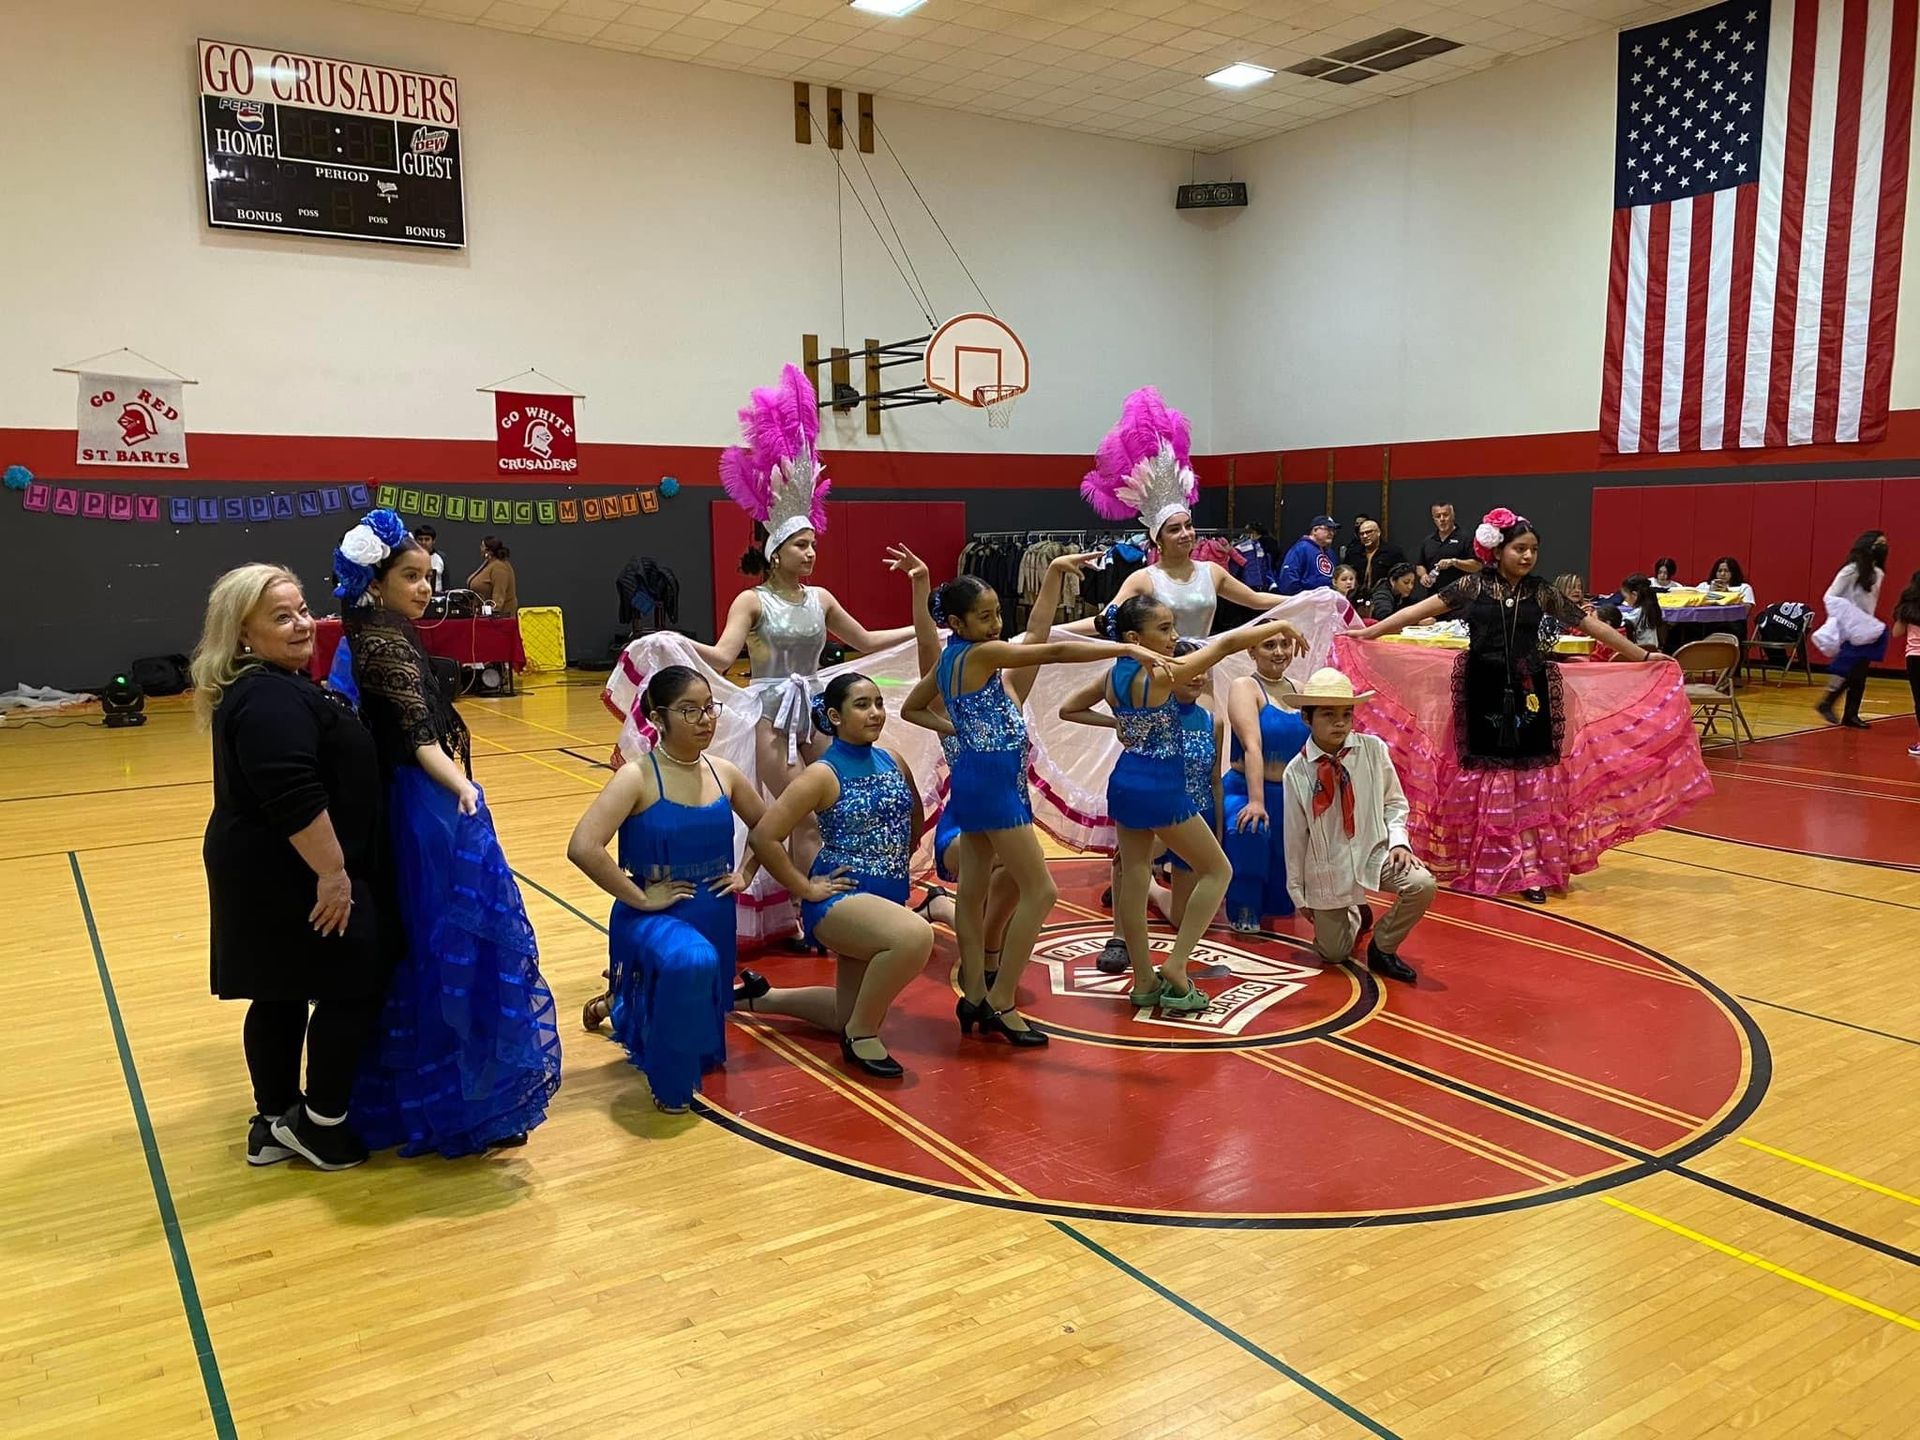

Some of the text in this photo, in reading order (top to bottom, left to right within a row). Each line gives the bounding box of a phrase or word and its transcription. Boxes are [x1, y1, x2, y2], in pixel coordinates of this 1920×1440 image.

[204, 44, 455, 123] GO CRUSADERS
[219, 97, 264, 114] PEPSI
[215, 128, 275, 158] HOME
[402, 152, 453, 180] GUEST
[315, 167, 369, 183] PERIOD
[237, 208, 282, 223] BONUS
[298, 208, 319, 217] POSS
[368, 215, 389, 224] POSS
[405, 225, 446, 239] BONUS
[90, 389, 178, 420] GO RED
[501, 407, 573, 437] GO WHITE
[82, 449, 111, 461] ST.
[499, 458, 577, 471] CRUSADERS
[27, 486, 657, 520] HAPPY HISPANIC HERITAGE MONTH
[1207, 983, 1267, 1015] BARTS
